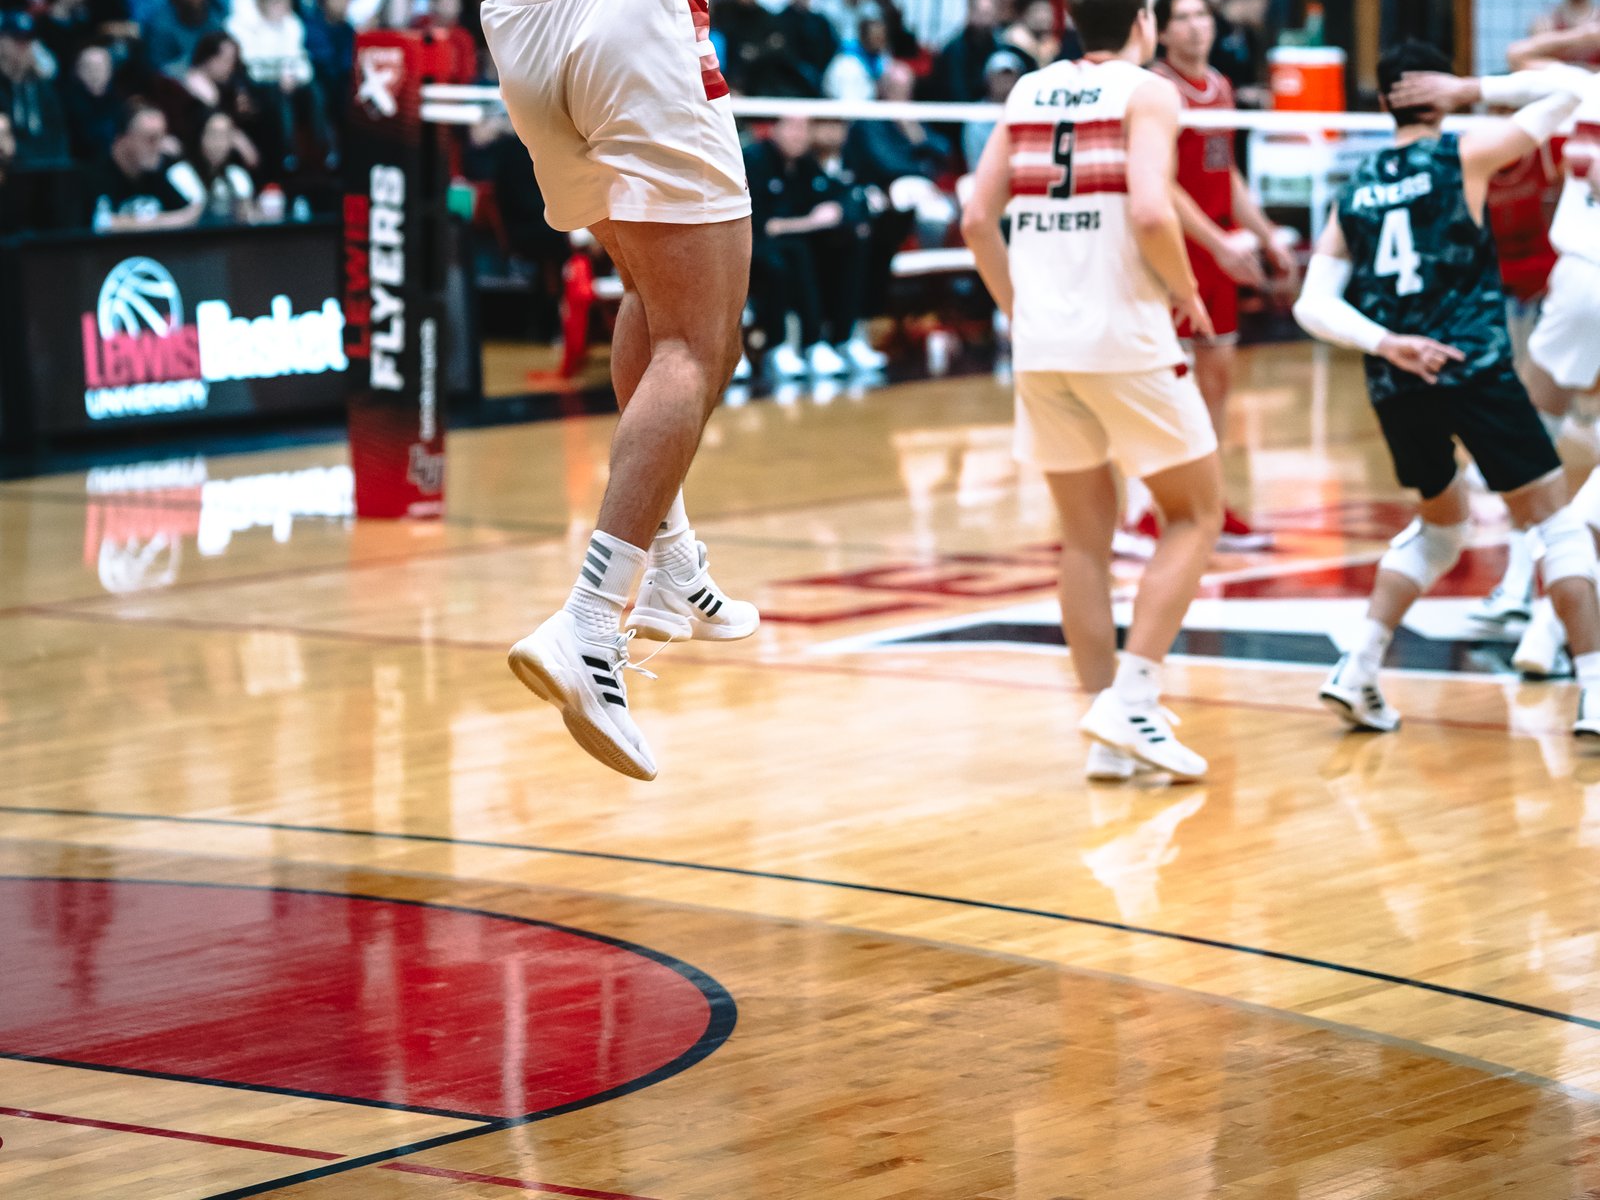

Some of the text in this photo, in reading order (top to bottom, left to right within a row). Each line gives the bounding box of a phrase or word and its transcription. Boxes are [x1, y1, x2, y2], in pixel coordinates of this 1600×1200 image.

[1050, 120, 1075, 199] 9
[369, 163, 405, 391] FLYERS
[1374, 208, 1425, 296] 4
